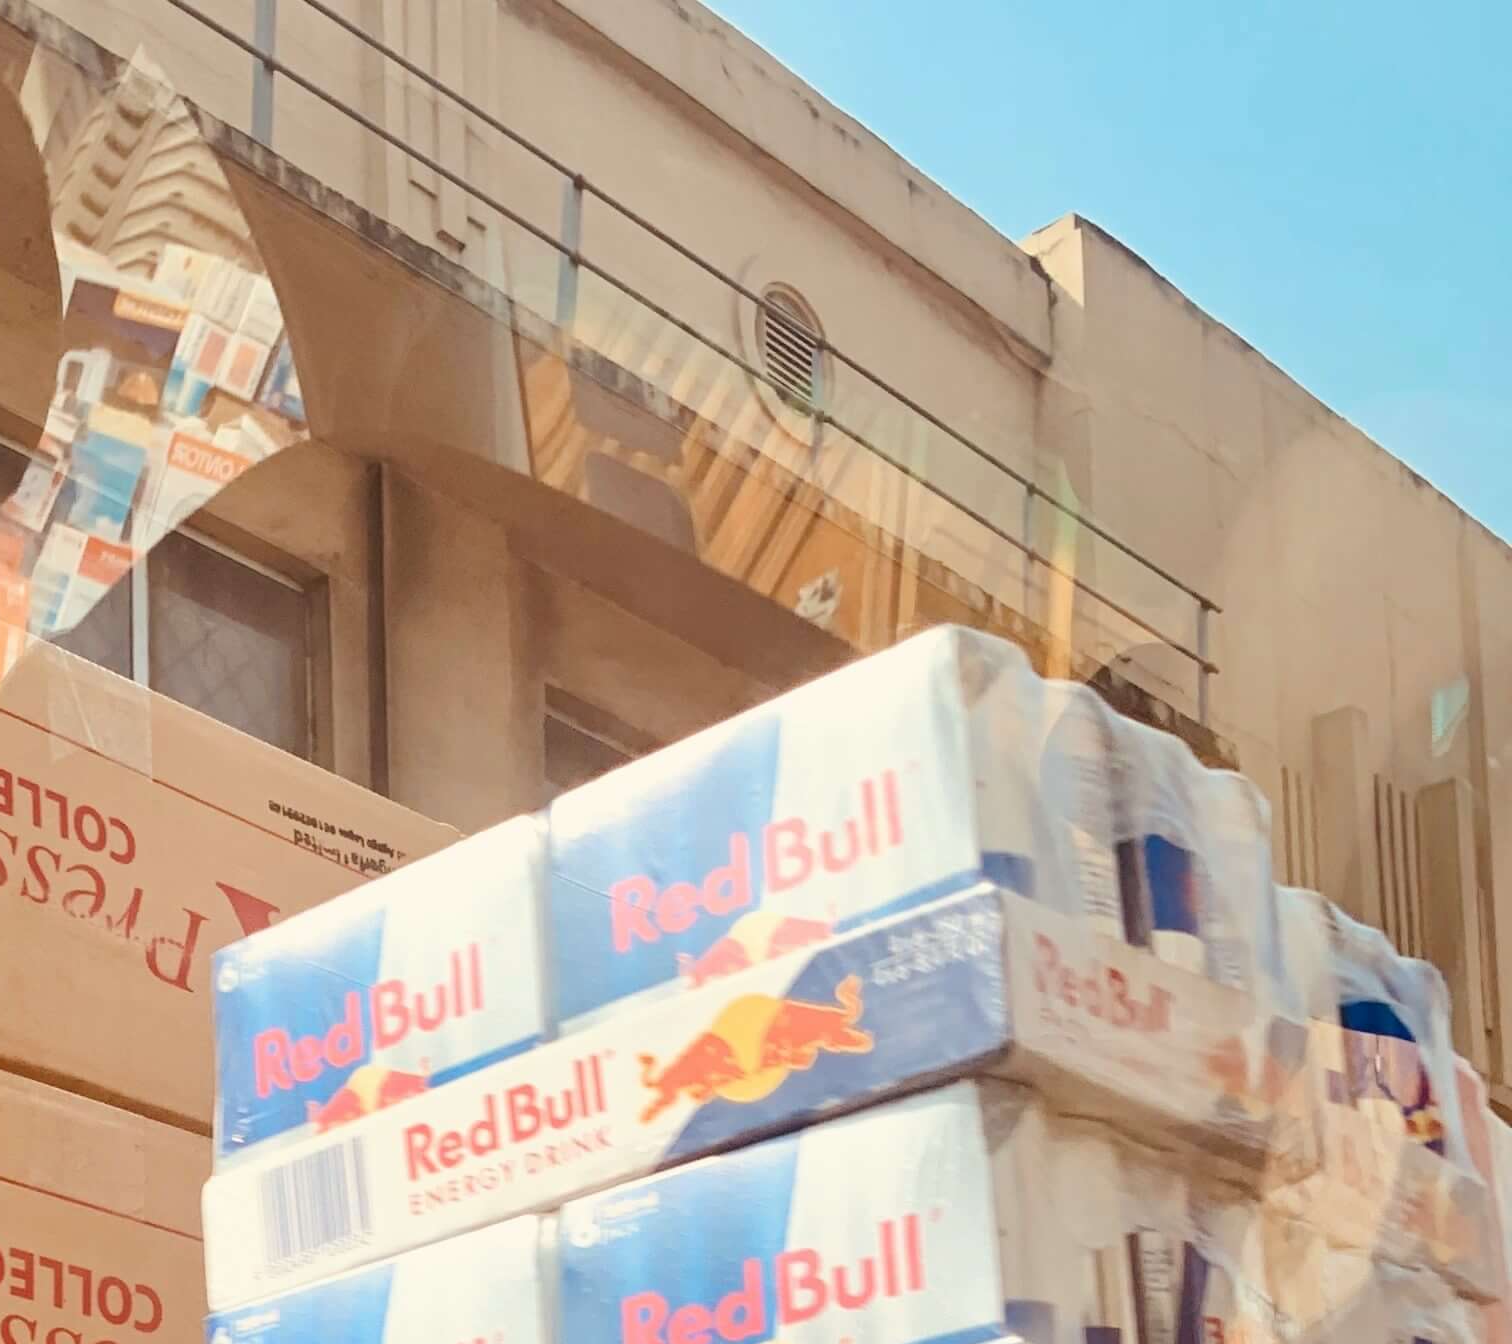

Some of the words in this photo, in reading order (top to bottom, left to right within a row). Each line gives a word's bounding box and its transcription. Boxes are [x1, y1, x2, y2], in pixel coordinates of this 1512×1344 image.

[610, 832, 755, 953] Red
[762, 768, 904, 894] Bull
[253, 988, 365, 1097] Red
[370, 942, 484, 1052] Bull
[406, 1091, 501, 1182] Red
[508, 1056, 609, 1144] Bull
[407, 1159, 517, 1217] ENERGY
[525, 1127, 614, 1177] DRINK
[775, 1211, 927, 1327] Bull
